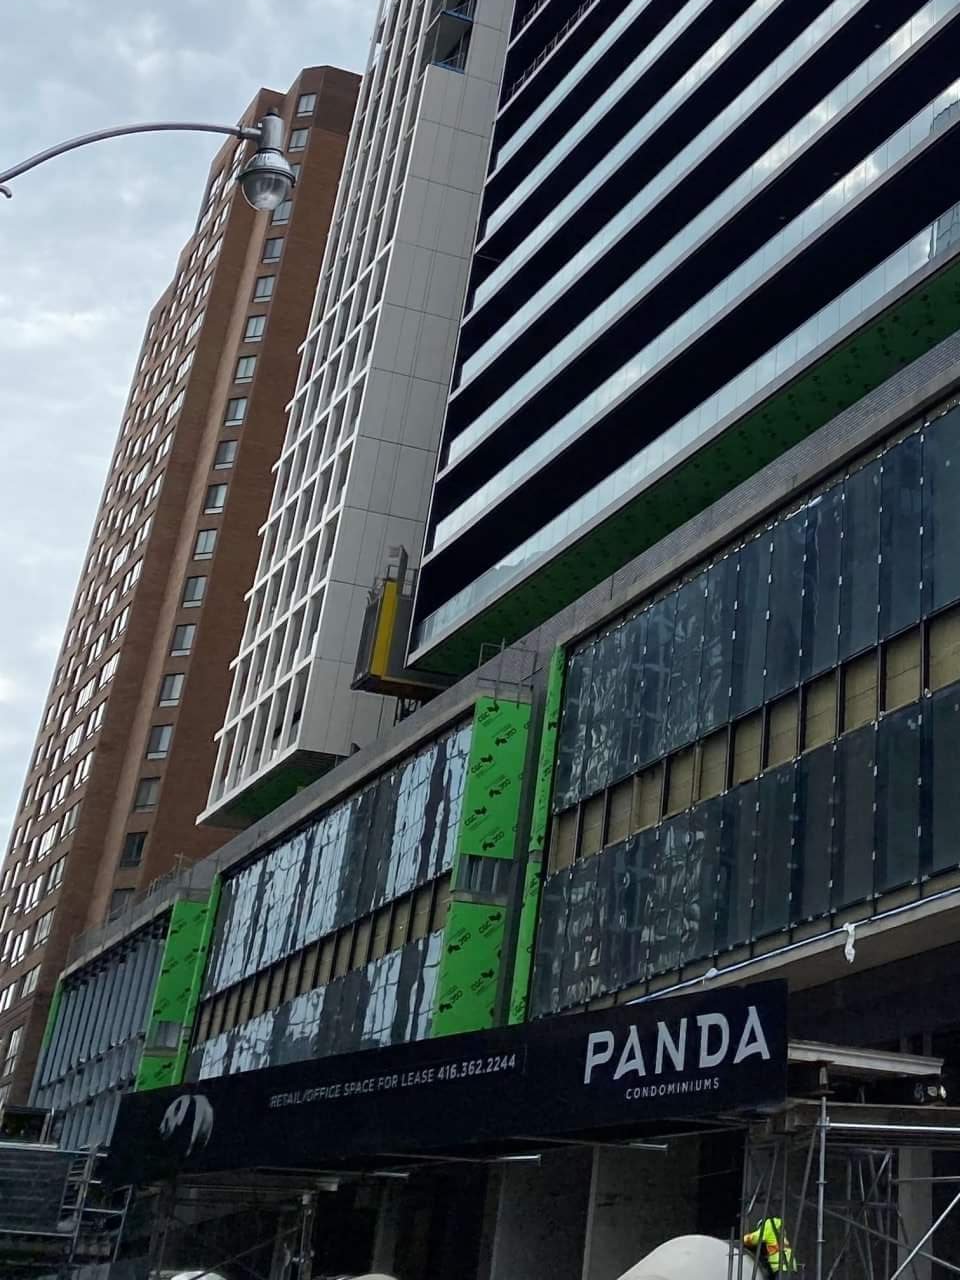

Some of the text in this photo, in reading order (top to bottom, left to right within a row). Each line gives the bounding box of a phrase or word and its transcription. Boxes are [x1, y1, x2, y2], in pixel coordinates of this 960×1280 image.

[584, 1006, 771, 1085] PANDA
[343, 1079, 376, 1096] SPACE
[377, 1074, 399, 1089] FOR
[400, 1068, 436, 1087] LEASE
[438, 1053, 517, 1080] 416.362.2244
[625, 1077, 720, 1100] CONDOMINIUMS
